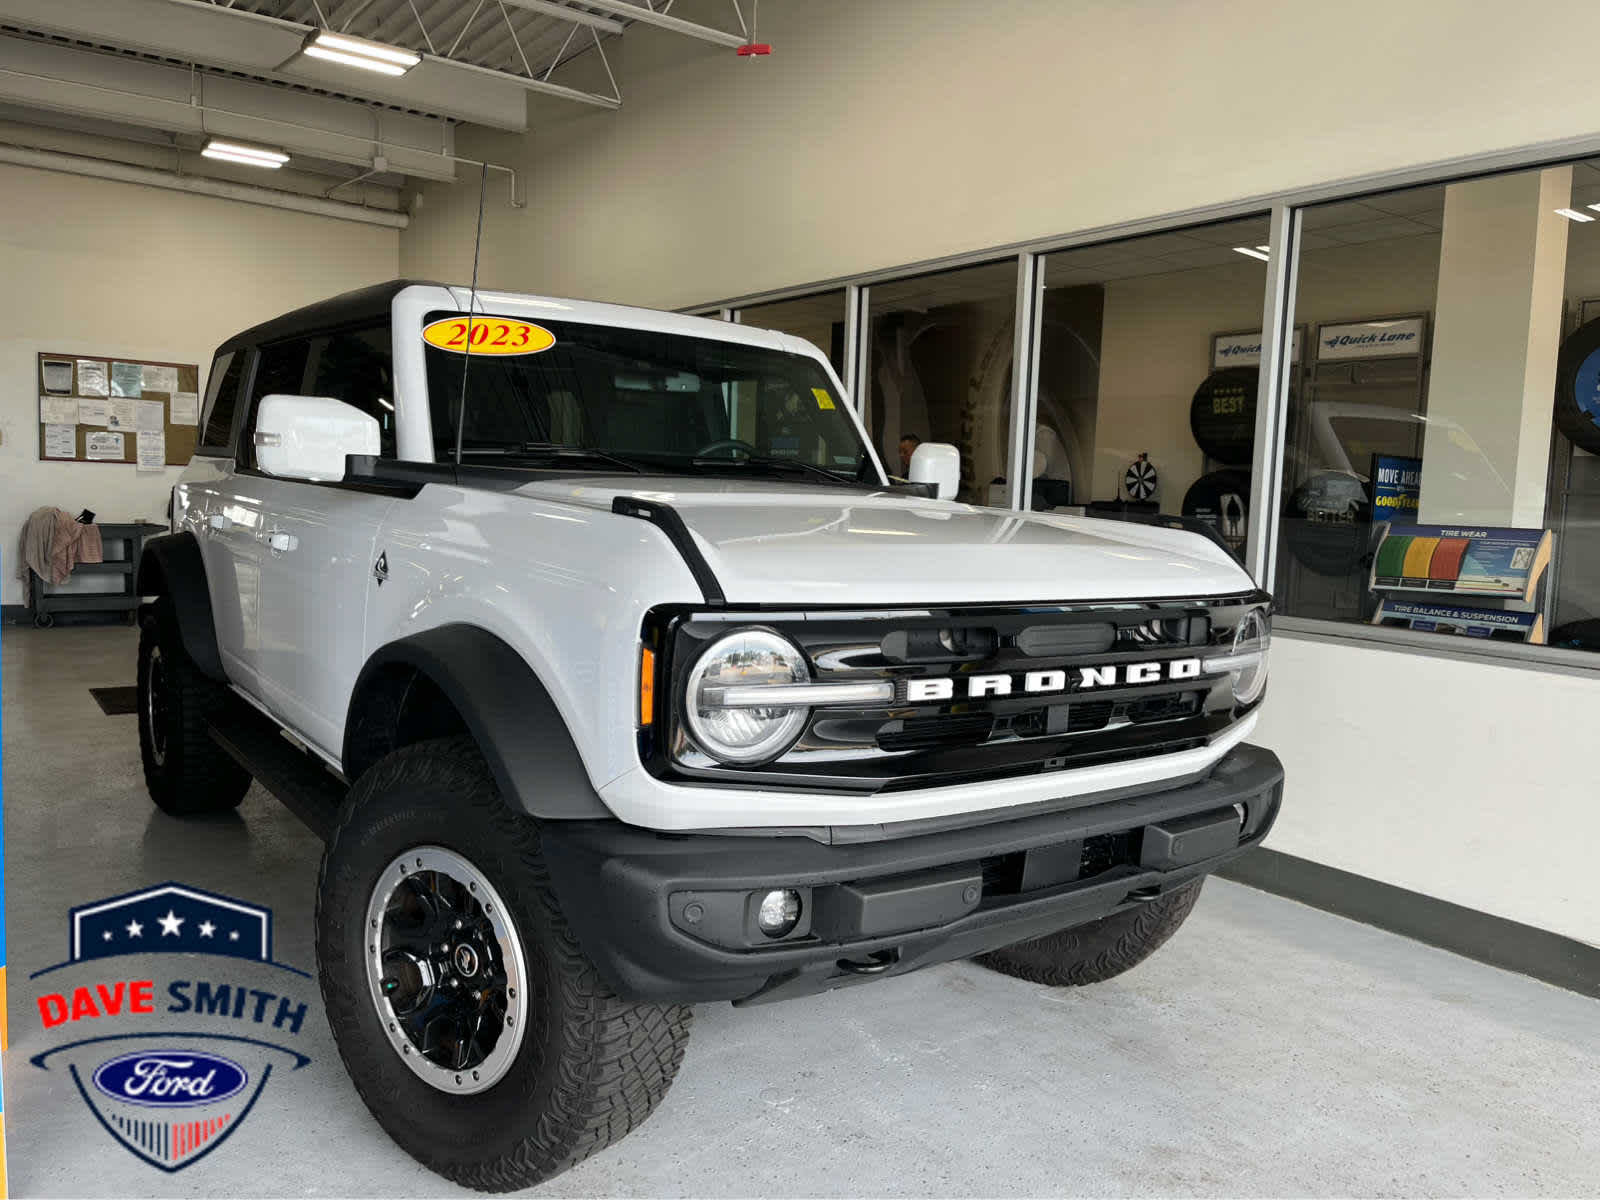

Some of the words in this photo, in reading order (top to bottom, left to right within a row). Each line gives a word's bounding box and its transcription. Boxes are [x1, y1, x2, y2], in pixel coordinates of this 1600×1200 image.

[445, 323, 531, 347] 2023
[1340, 332, 1378, 346] Quick
[1378, 332, 1416, 342] Lane
[1213, 396, 1246, 415] BEST
[1377, 467, 1400, 484] MOVE
[1440, 529, 1459, 537] TIRE
[1461, 530, 1488, 538] WEAR
[1393, 604, 1412, 613] TIRE
[1412, 607, 1452, 618] BALANCE
[1452, 609, 1459, 618] &
[1460, 611, 1519, 624] SUSPENSION
[906, 658, 1201, 702] BRONCO
